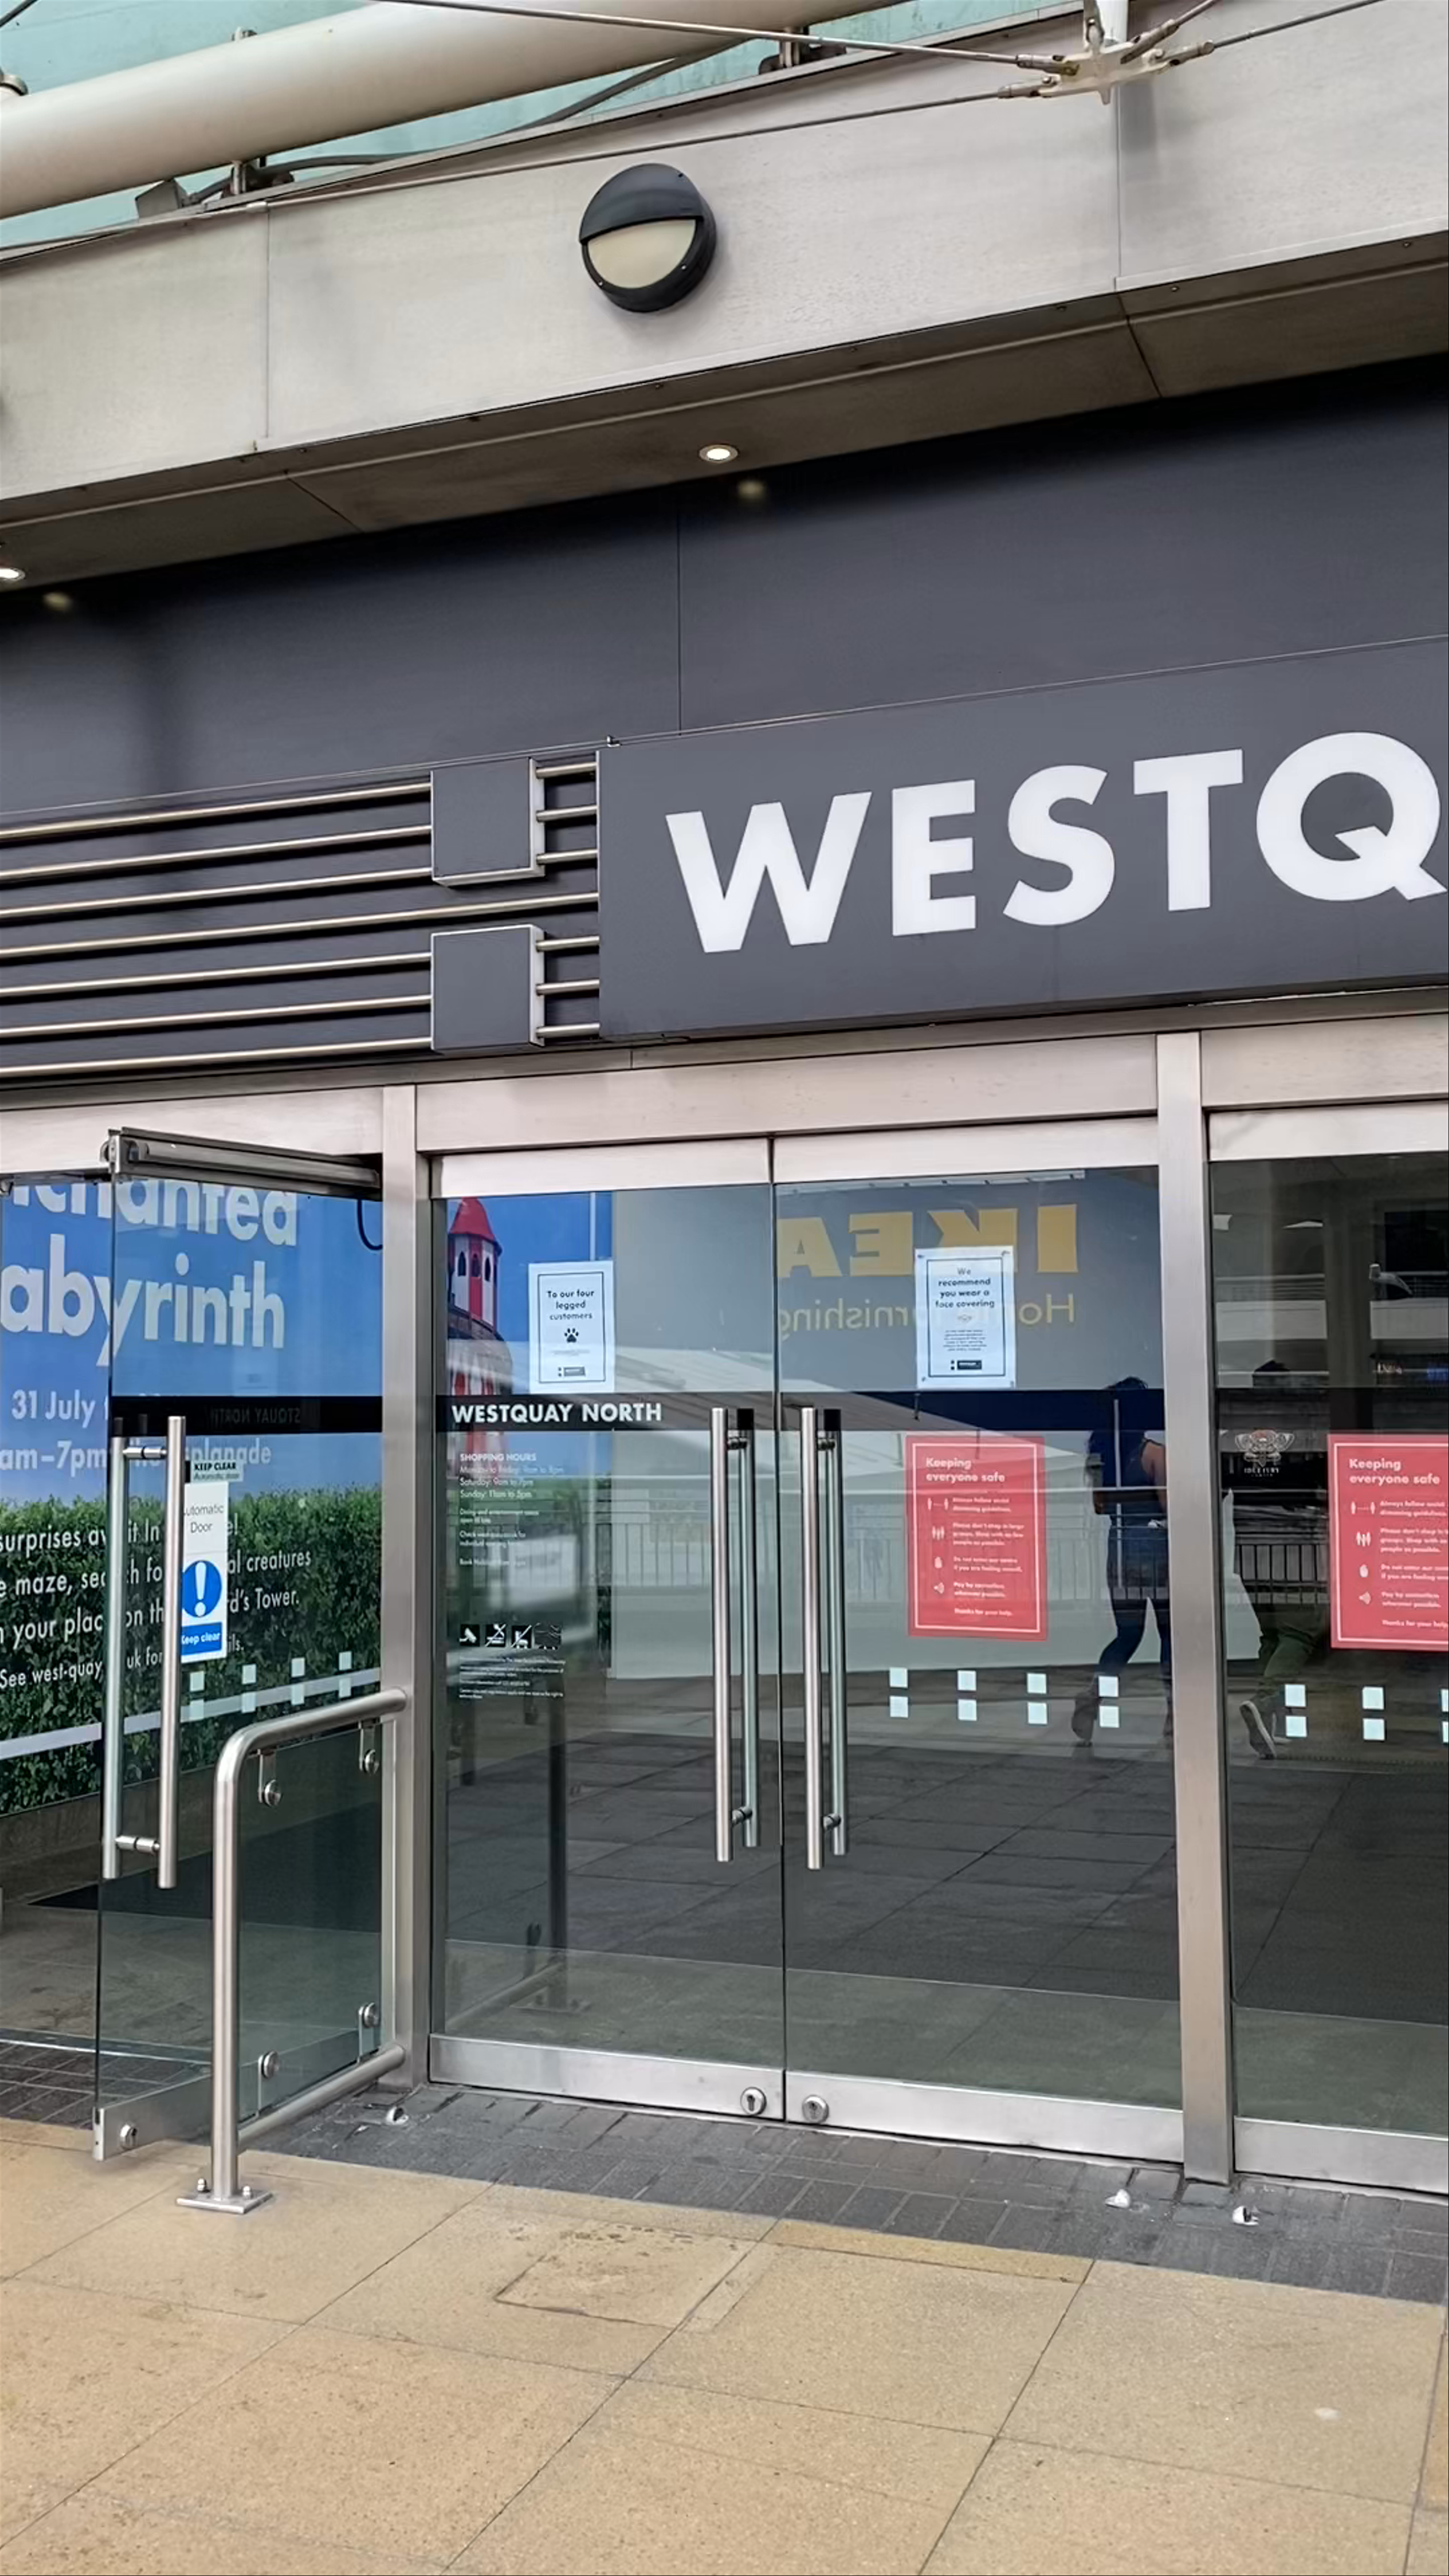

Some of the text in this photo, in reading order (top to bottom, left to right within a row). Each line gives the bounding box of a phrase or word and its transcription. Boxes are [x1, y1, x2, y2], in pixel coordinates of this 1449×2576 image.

[665, 732, 1448, 953] WESTQ
[938, 1278, 991, 1286] recommend
[577, 1289, 594, 1297] four
[556, 1301, 586, 1310] legged
[956, 1300, 995, 1308] covering
[11, 1390, 37, 1419] 31
[45, 1389, 95, 1429] July
[452, 1403, 662, 1423] WESTQUAY NORTH
[926, 1457, 971, 1470] Keeping
[1349, 1457, 1401, 1472] Keeping
[926, 1472, 1005, 1484] everyone safe
[1349, 1473, 1440, 1487] everyone safe
[185, 1504, 224, 1516] utomatic
[191, 1521, 213, 1533] Door
[246, 1550, 311, 1572] creatures
[15, 1574, 72, 1595] maze,
[146, 1557, 162, 1582] fo
[13, 1620, 57, 1650] your
[65, 1606, 103, 1642] plac
[150, 1597, 164, 1624] th
[255, 1587, 299, 1609] Tower.
[0, 1669, 26, 1689] See
